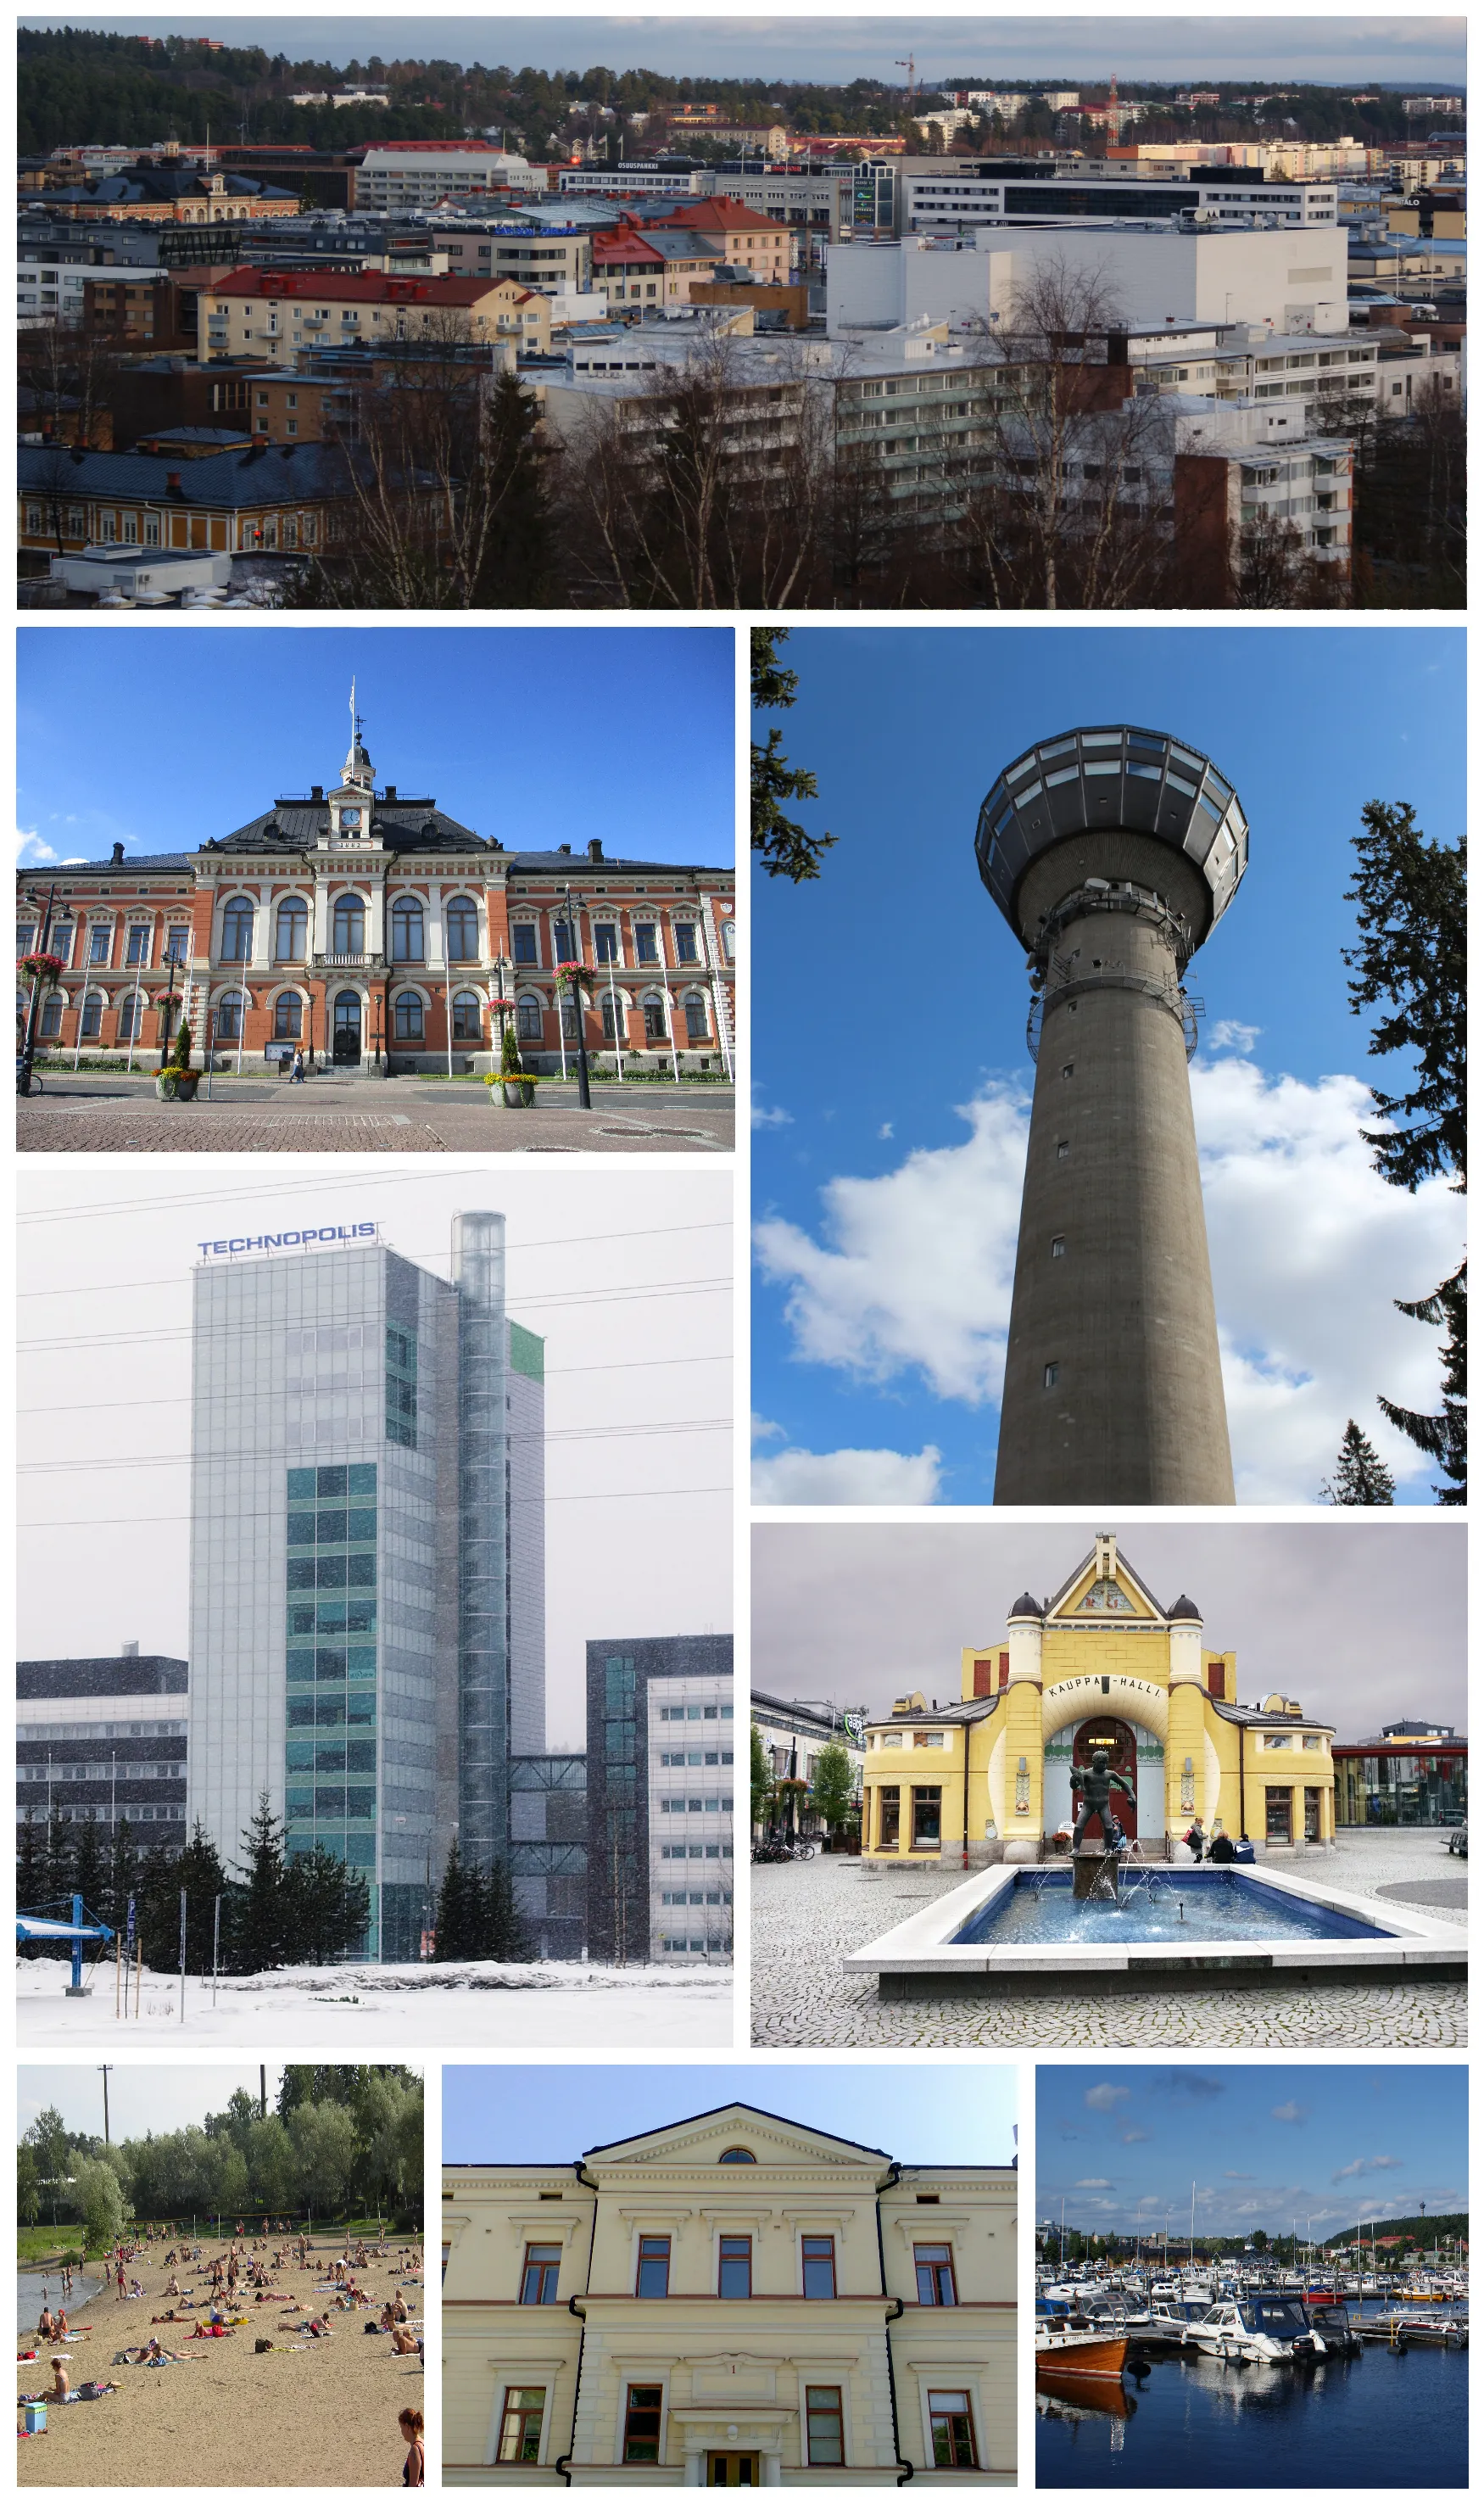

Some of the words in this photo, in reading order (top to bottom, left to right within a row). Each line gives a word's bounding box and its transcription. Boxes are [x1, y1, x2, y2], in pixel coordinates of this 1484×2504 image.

[495, 226, 535, 236] CARLSON
[197, 1222, 376, 1255] TECHNOPOLIS
[1048, 1676, 1101, 1697] KAUPPA
[731, 2364, 736, 2374] 1
